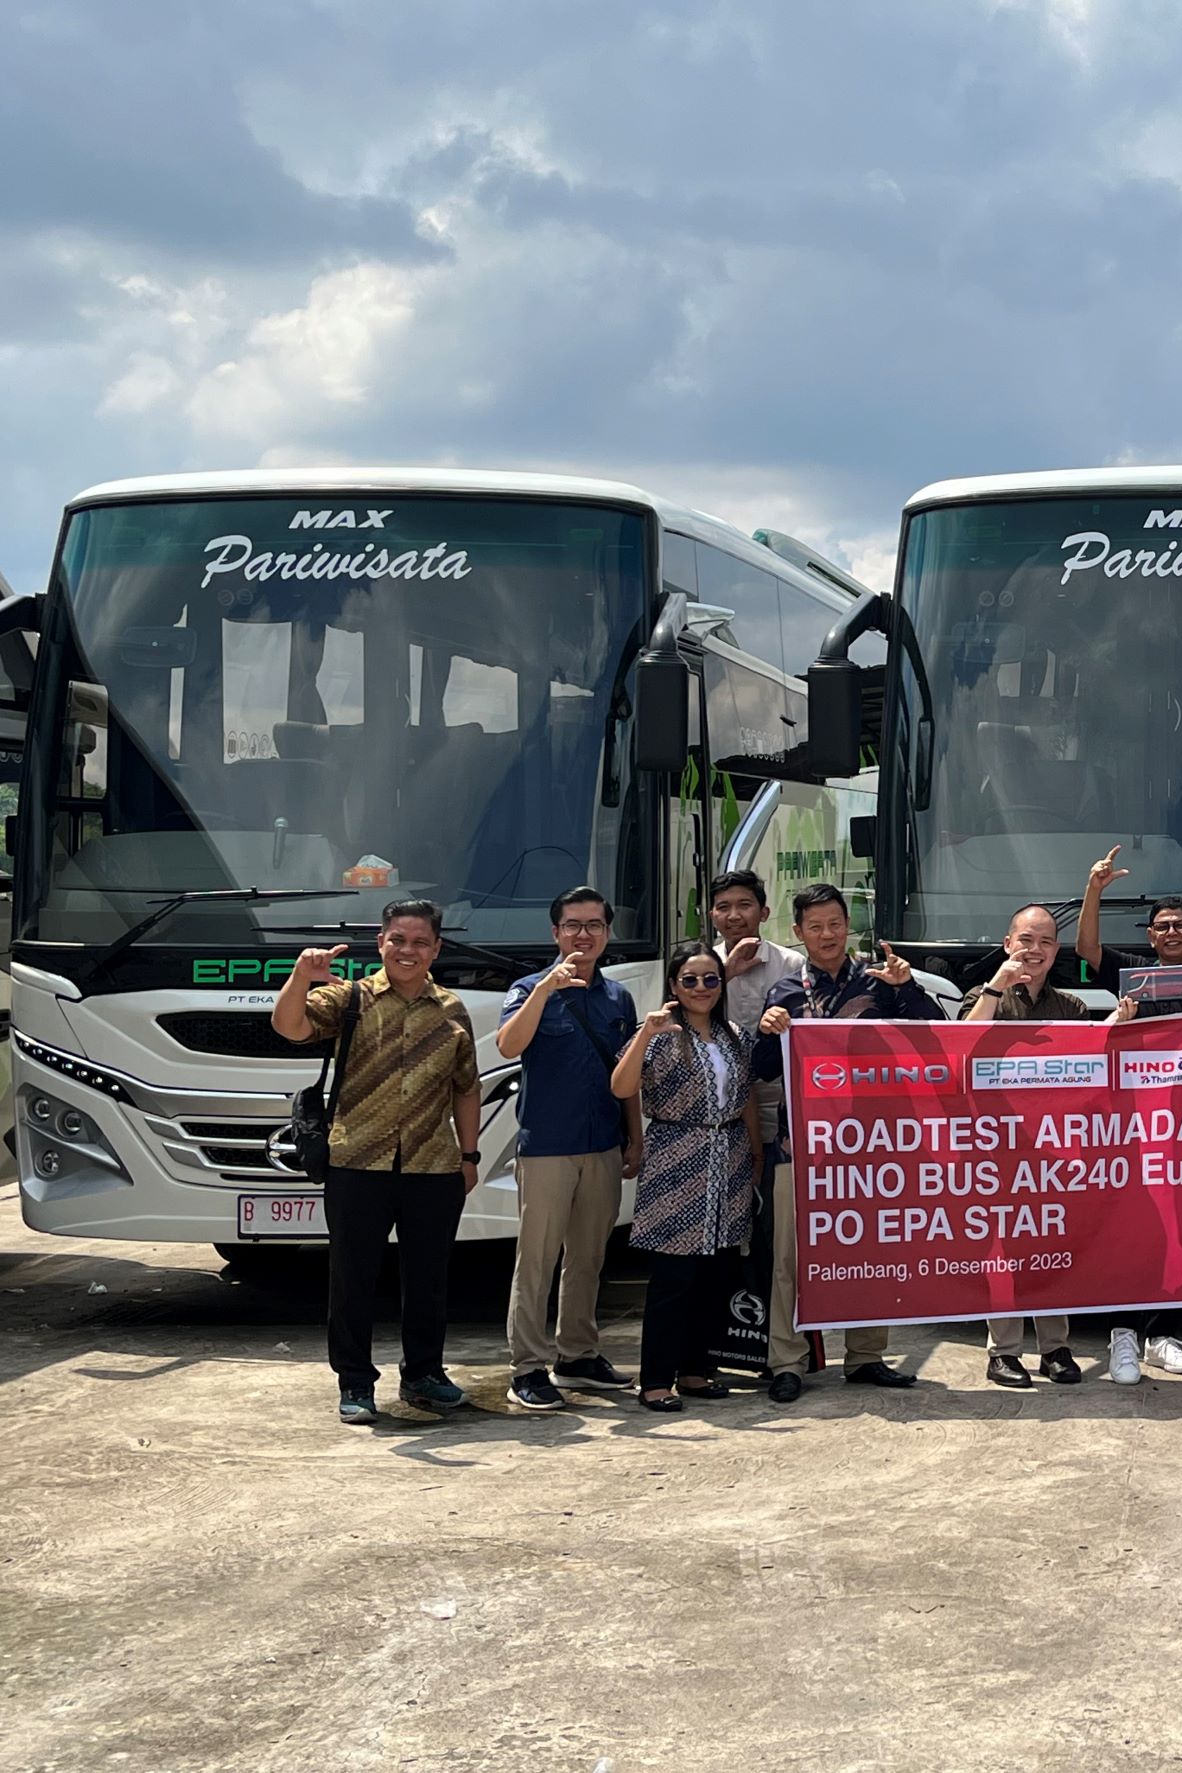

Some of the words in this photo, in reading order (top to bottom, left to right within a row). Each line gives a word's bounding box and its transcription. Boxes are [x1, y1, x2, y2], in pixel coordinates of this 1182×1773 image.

[288, 510, 394, 529] MAX
[201, 535, 472, 588] Pariwisata
[228, 995, 245, 1004] PT
[248, 995, 275, 1004] EKA
[852, 1064, 949, 1084] HINO
[976, 1060, 1037, 1077] EPA
[1044, 1059, 1104, 1075] Star
[1124, 1062, 1175, 1073] HINO
[807, 1115, 1024, 1154] ROADTEST
[808, 1162, 905, 1200] HINO
[919, 1161, 1000, 1196] BUS
[1010, 1156, 1129, 1194] AK240
[244, 1201, 254, 1221] B
[271, 1201, 316, 1221] 9977
[808, 1209, 864, 1246] PO
[878, 1207, 954, 1244] EPA
[964, 1203, 1066, 1241] STAR
[808, 1262, 912, 1283] Palembang,
[918, 1259, 929, 1276] 6
[936, 1256, 1024, 1275] Desember
[1030, 1251, 1073, 1270] 2023
